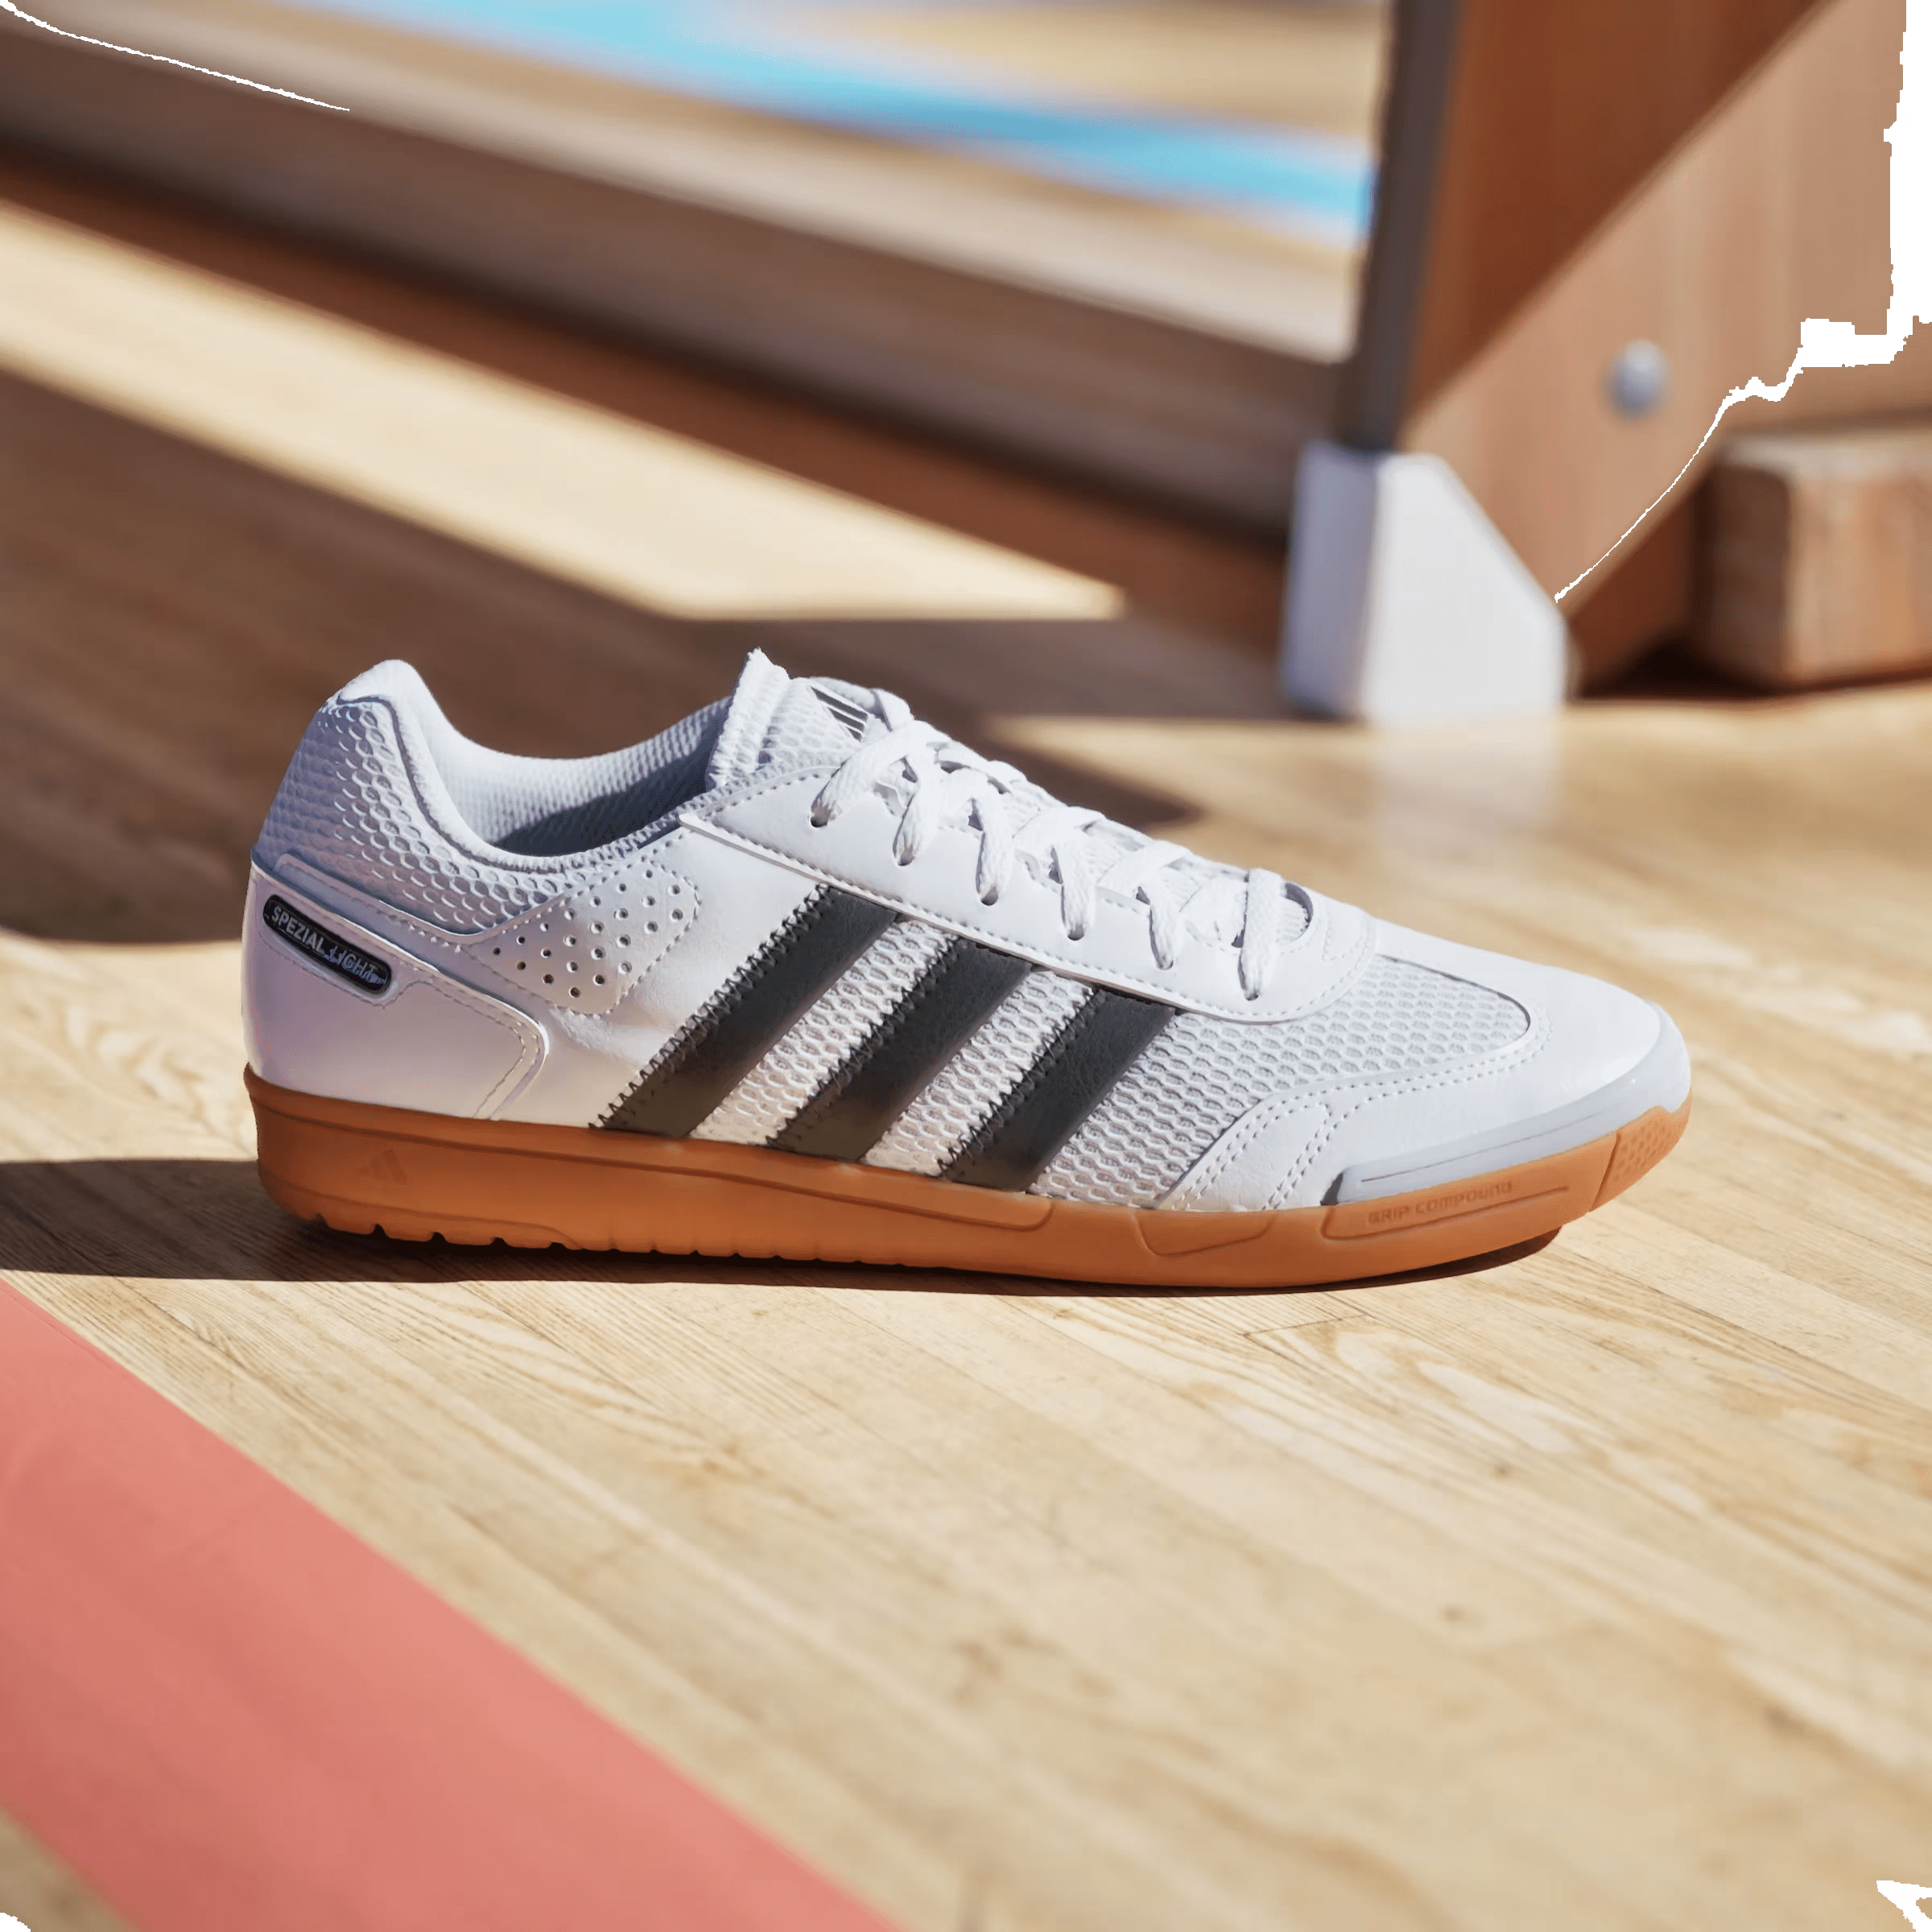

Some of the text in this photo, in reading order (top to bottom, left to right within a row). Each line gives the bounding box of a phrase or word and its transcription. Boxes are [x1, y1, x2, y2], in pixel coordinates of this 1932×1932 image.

[271, 906, 378, 980] SPEZIAL LIGHT
[1368, 1181, 1513, 1224] GRIP COMPOUND
